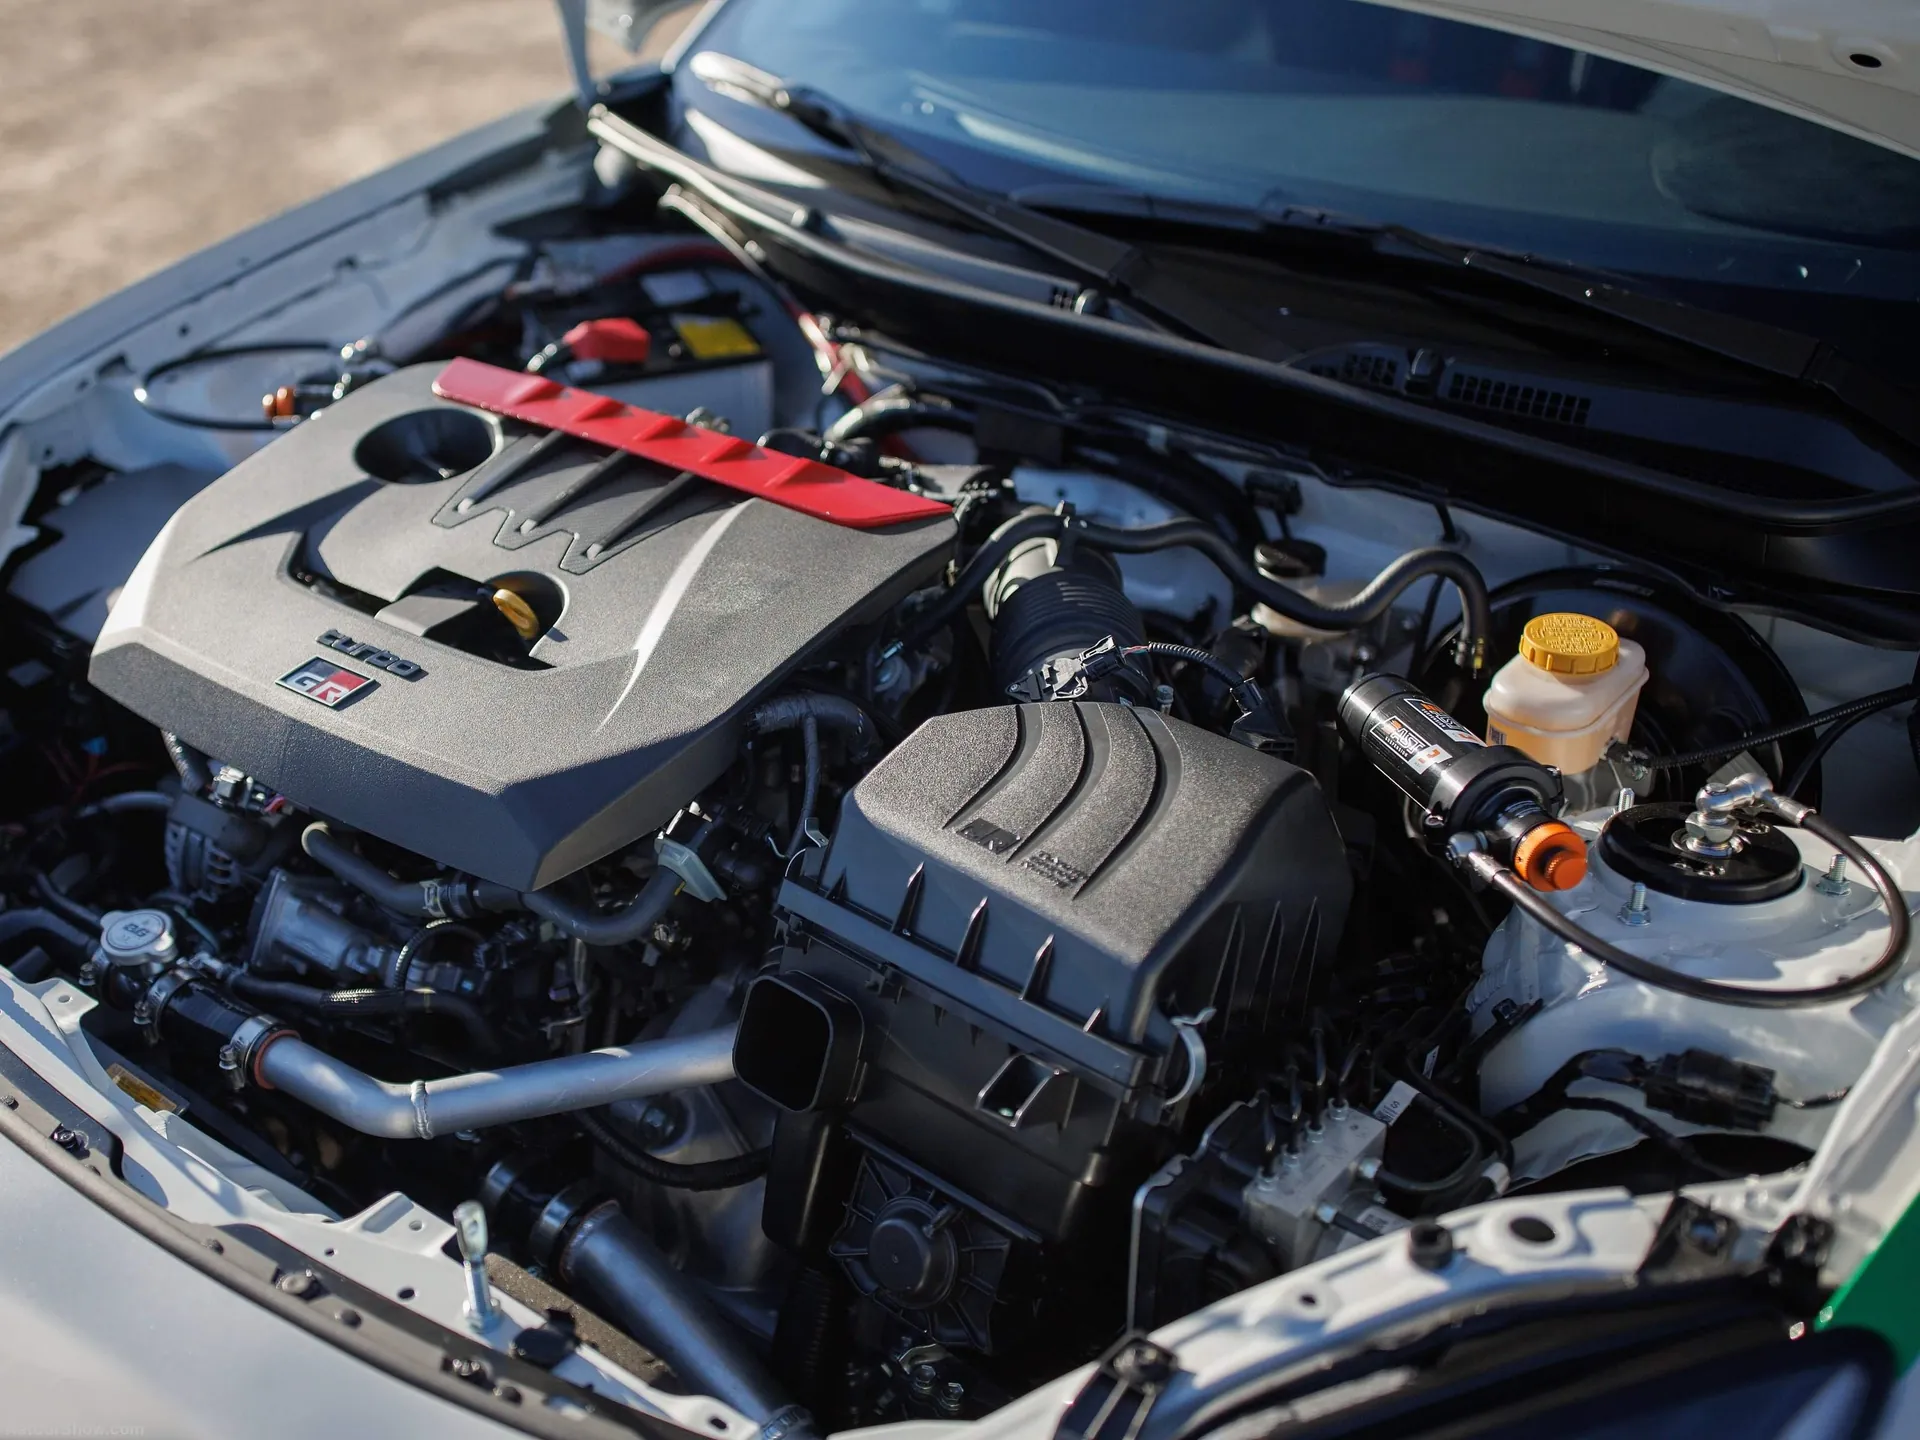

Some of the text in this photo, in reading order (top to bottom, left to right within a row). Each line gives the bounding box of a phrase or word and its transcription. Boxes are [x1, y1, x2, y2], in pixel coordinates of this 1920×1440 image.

[316, 628, 421, 677] turbo
[286, 671, 349, 704] GR
[1389, 728, 1425, 754] AST
